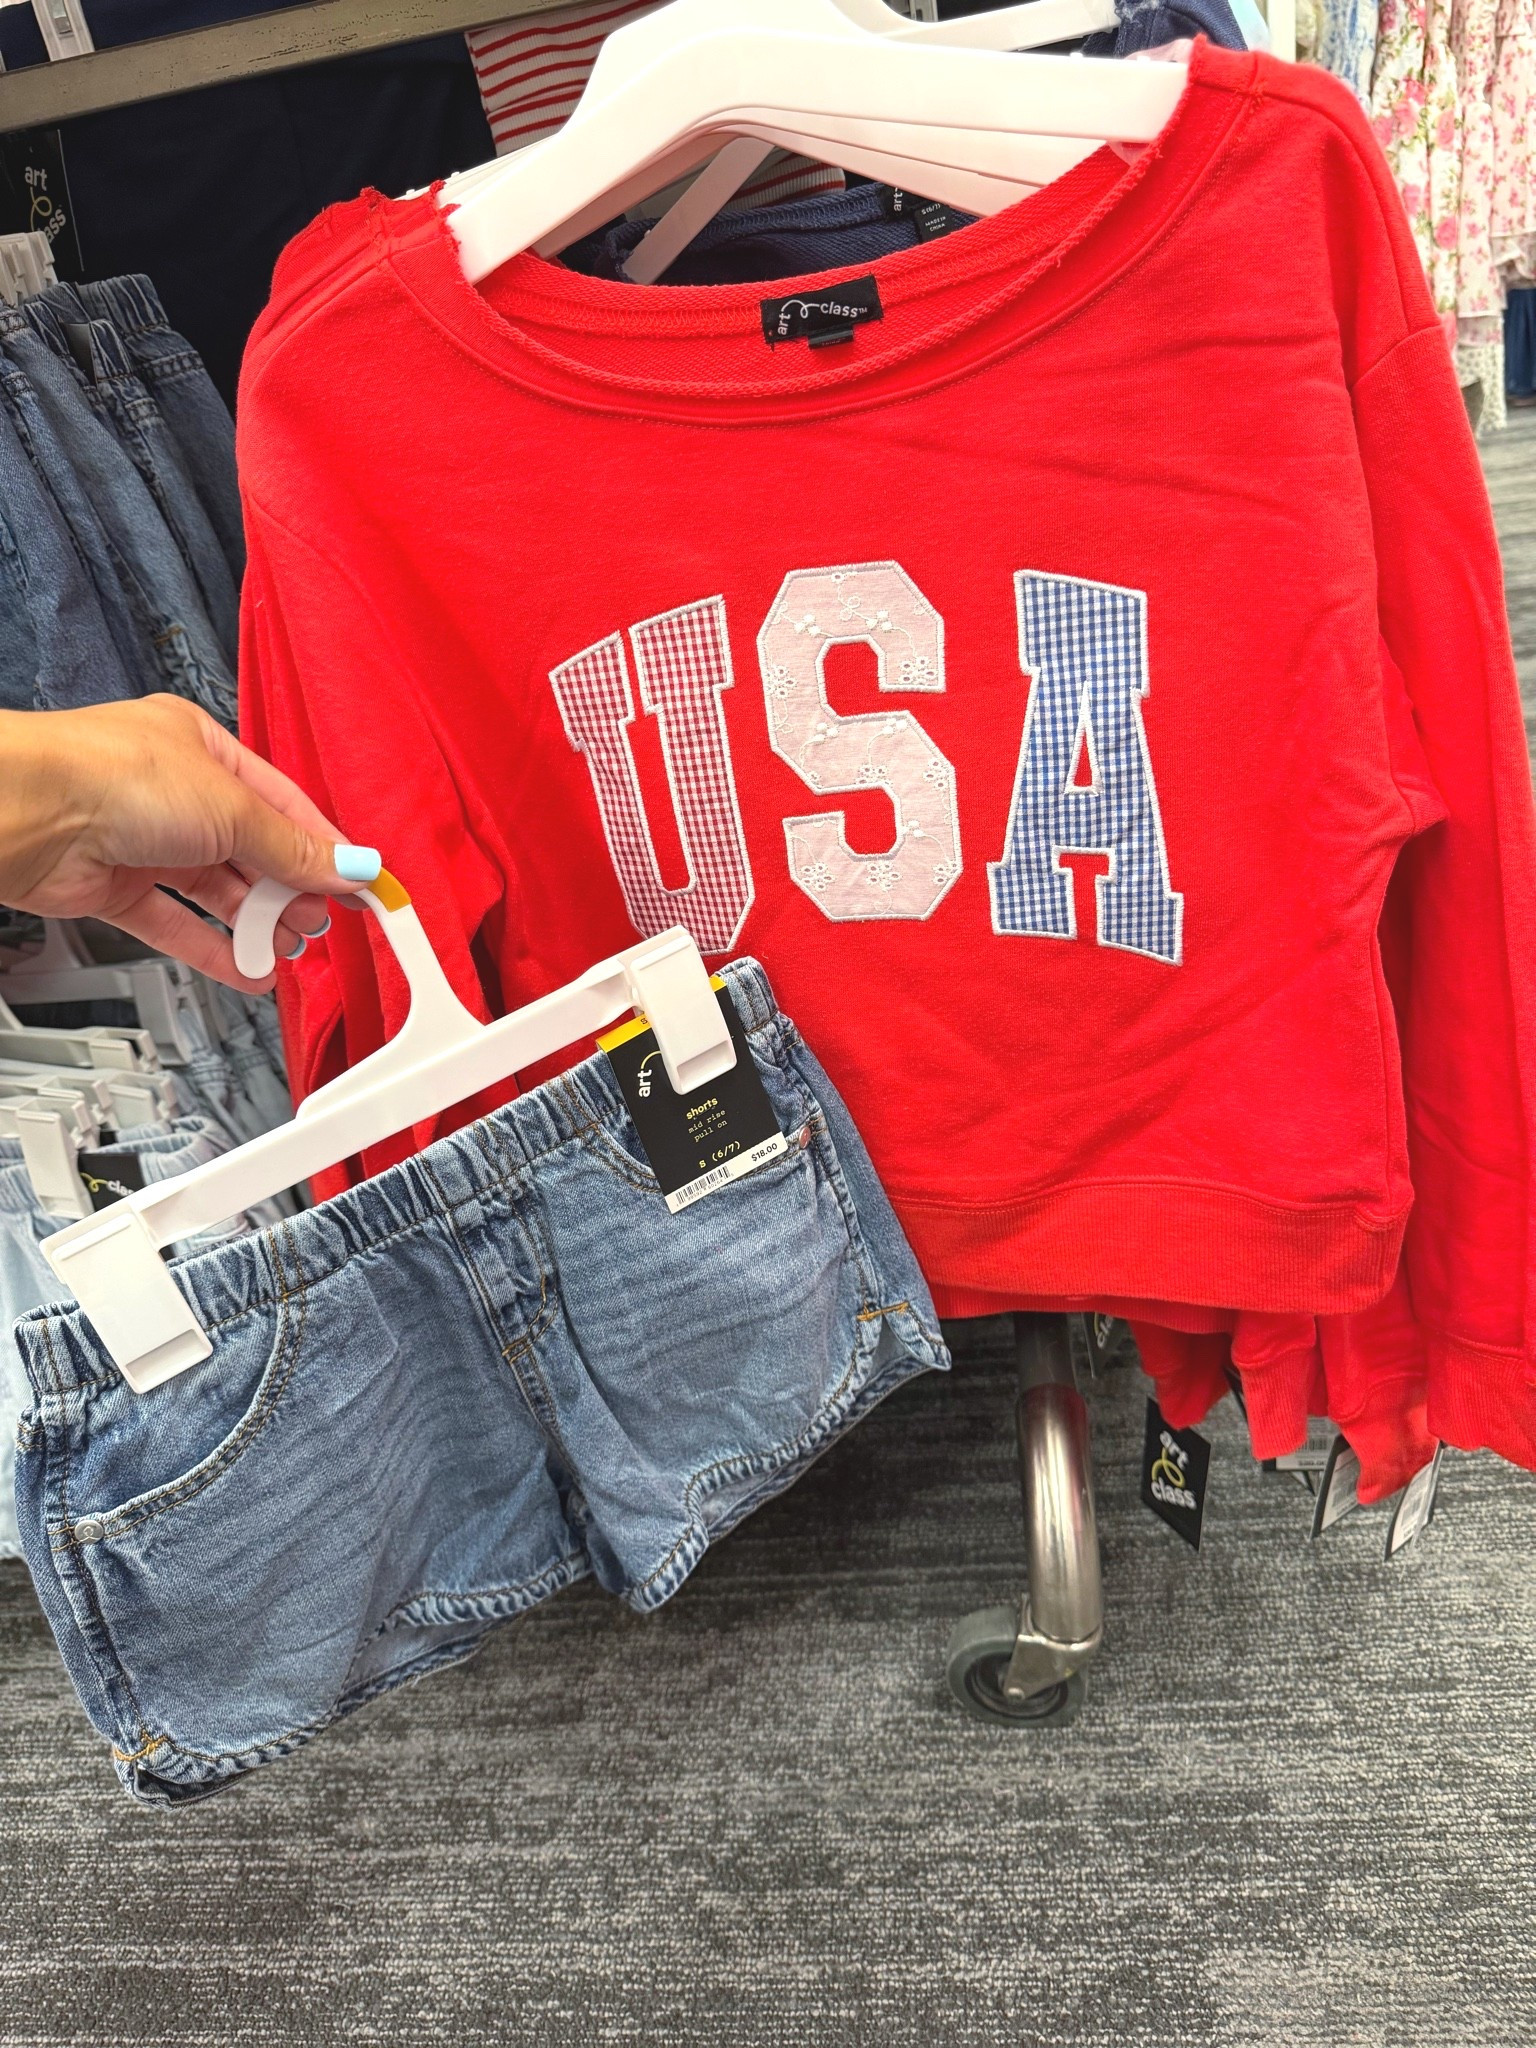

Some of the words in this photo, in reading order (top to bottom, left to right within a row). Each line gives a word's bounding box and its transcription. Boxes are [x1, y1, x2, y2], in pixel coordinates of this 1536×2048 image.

[24, 166, 48, 191] art
[893, 192, 903, 212] art
[777, 312, 791, 336] art
[548, 560, 1184, 967] USA
[637, 1069, 653, 1098] art
[686, 1097, 718, 1120] shorts
[688, 1121, 704, 1134] mid
[706, 1109, 726, 1124] rise
[694, 1126, 714, 1143] pull
[717, 1119, 728, 1129] on
[711, 1140, 741, 1162] (6/7)
[751, 1142, 778, 1162] $18.00
[1159, 1431, 1189, 1471] art
[1151, 1476, 1198, 1511] class
